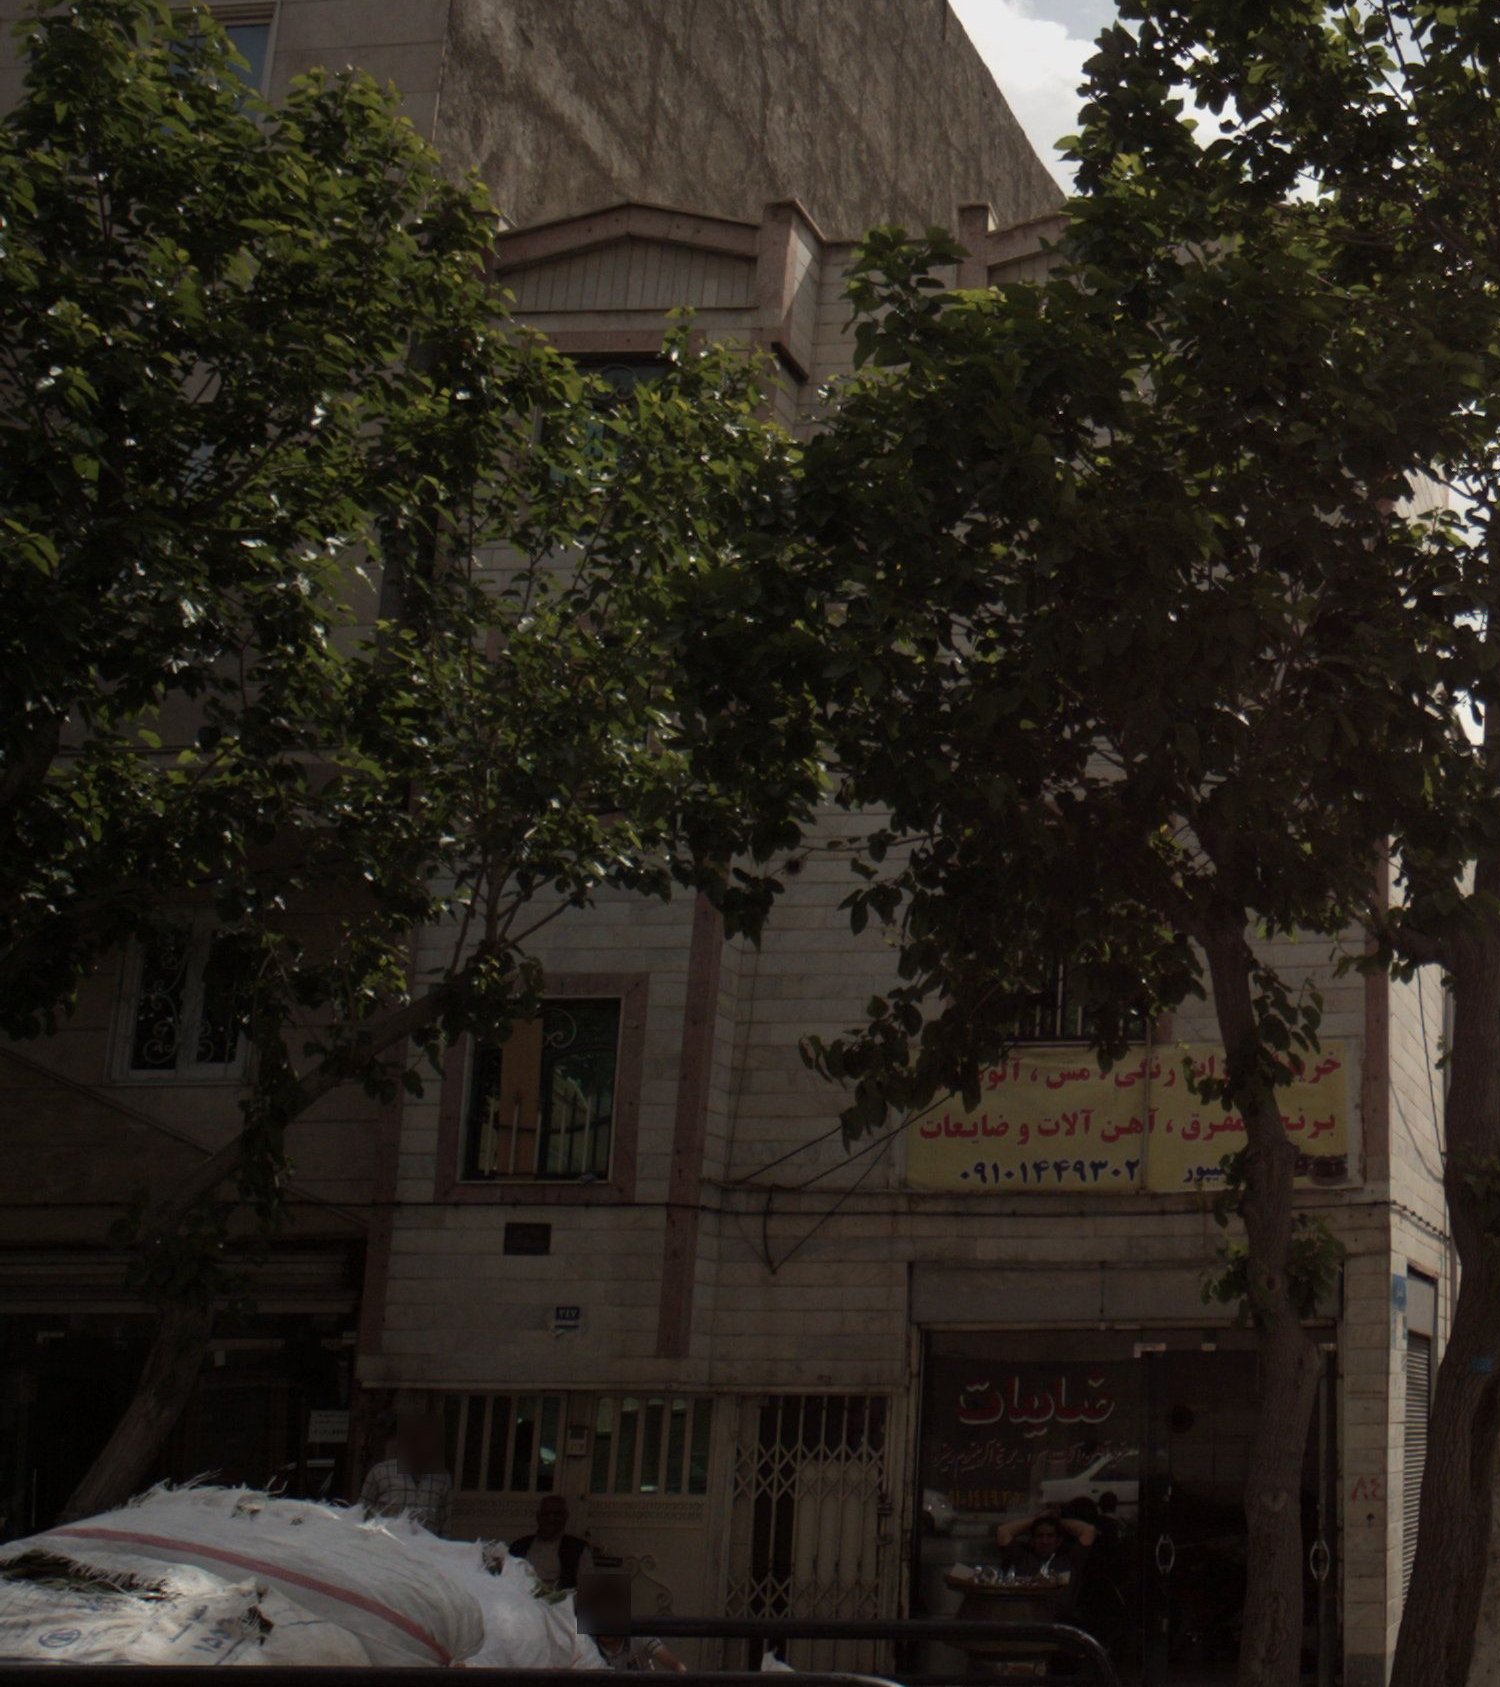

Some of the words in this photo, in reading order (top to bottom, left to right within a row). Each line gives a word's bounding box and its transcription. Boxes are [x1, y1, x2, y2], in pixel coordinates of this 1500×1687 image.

[919, 1113, 1010, 1144] ضایعات
[1017, 1121, 1031, 1146] و
[1037, 1107, 1096, 1138] آلات
[1100, 1107, 1160, 1143] آهن
